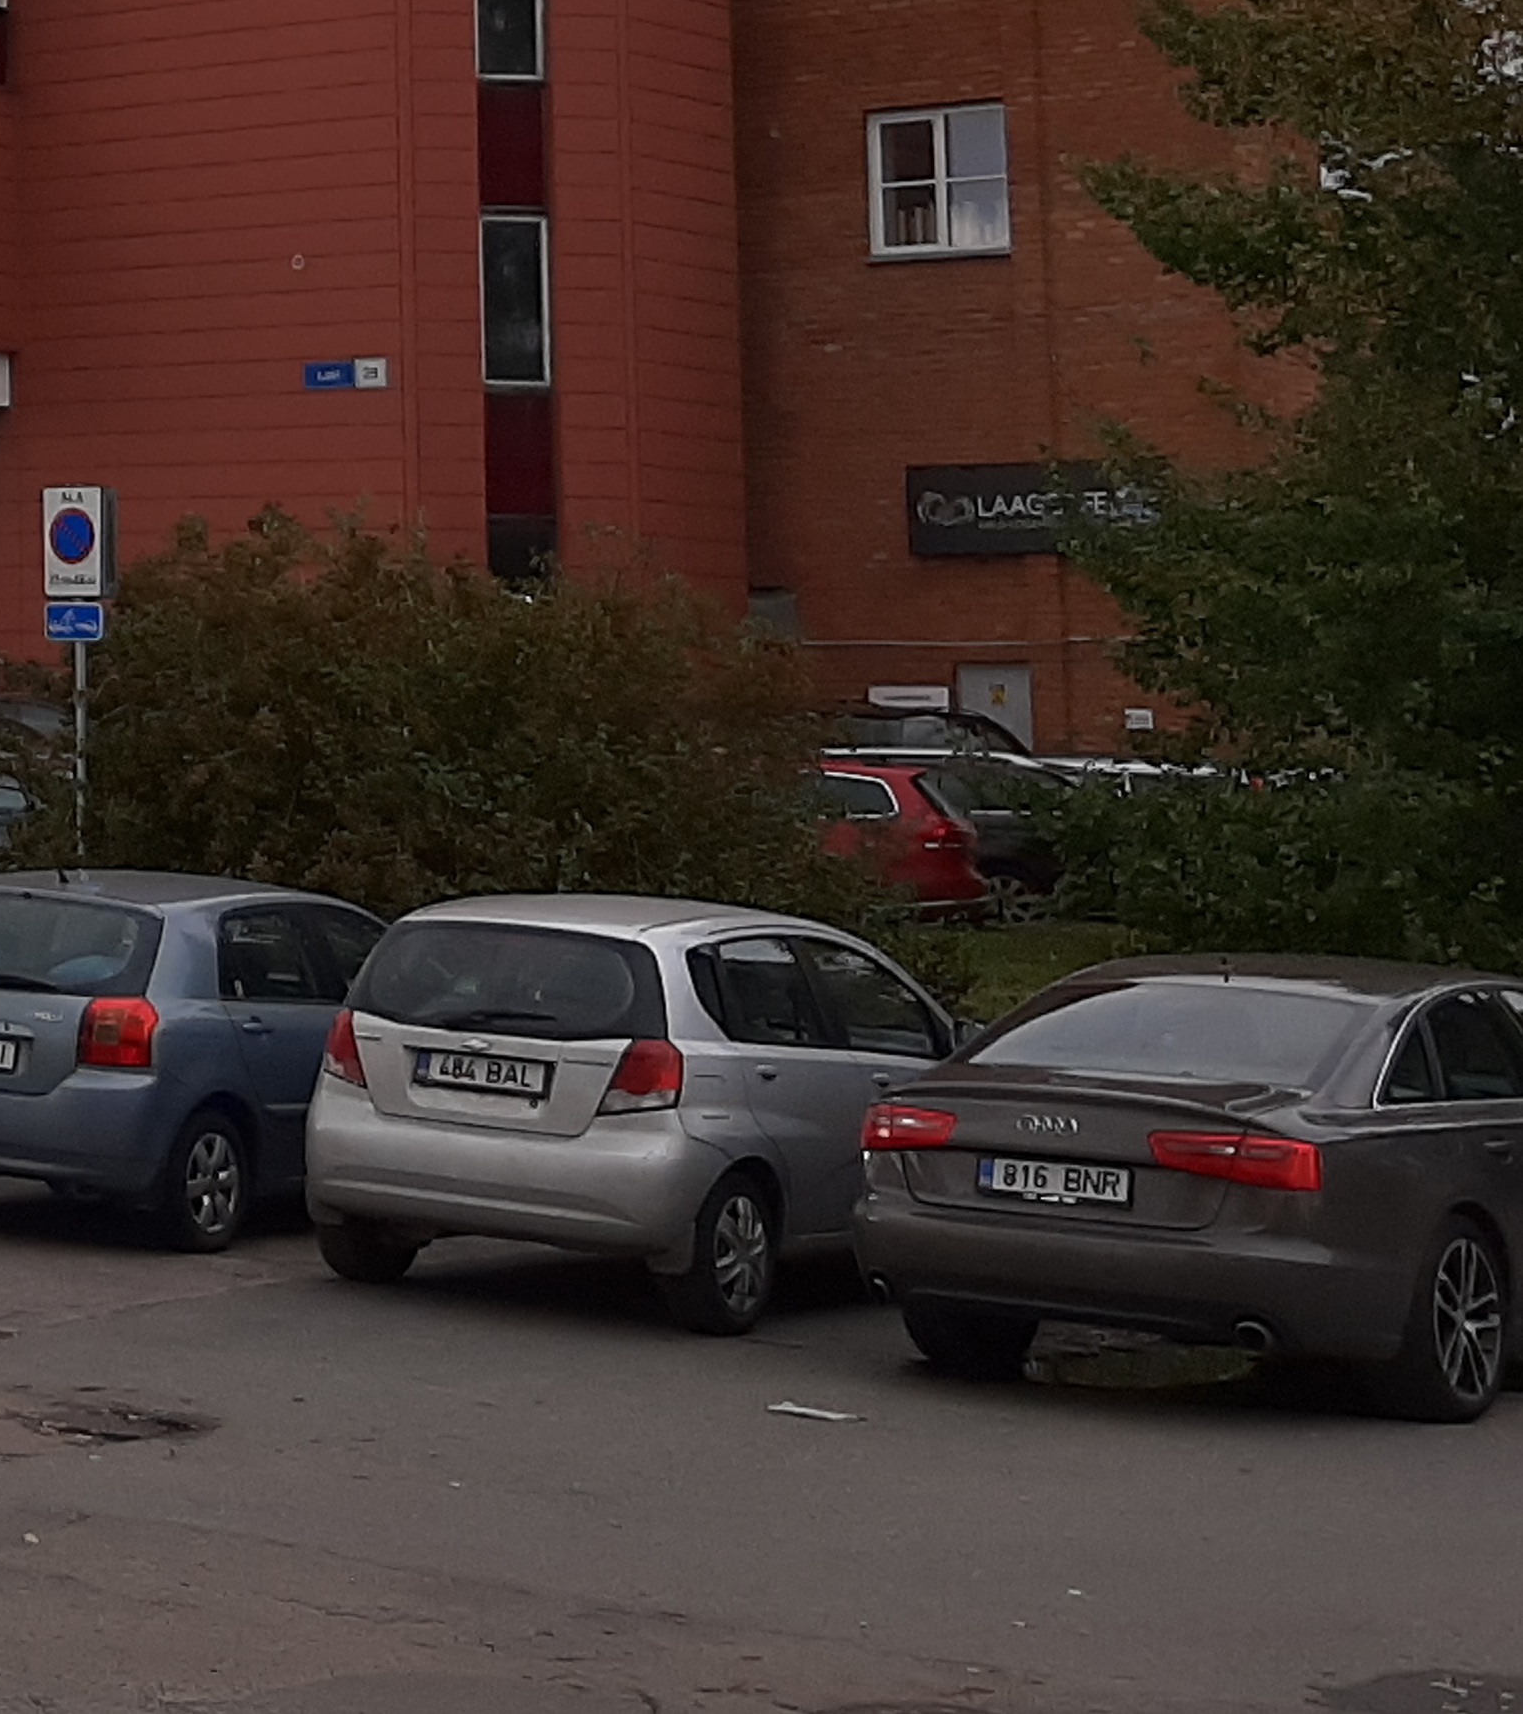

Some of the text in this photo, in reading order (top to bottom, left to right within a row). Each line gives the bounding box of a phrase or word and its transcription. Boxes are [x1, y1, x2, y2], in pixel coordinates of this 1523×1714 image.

[485, 1060, 531, 1088] BAL
[1003, 1162, 1121, 1198] 816 BNR
